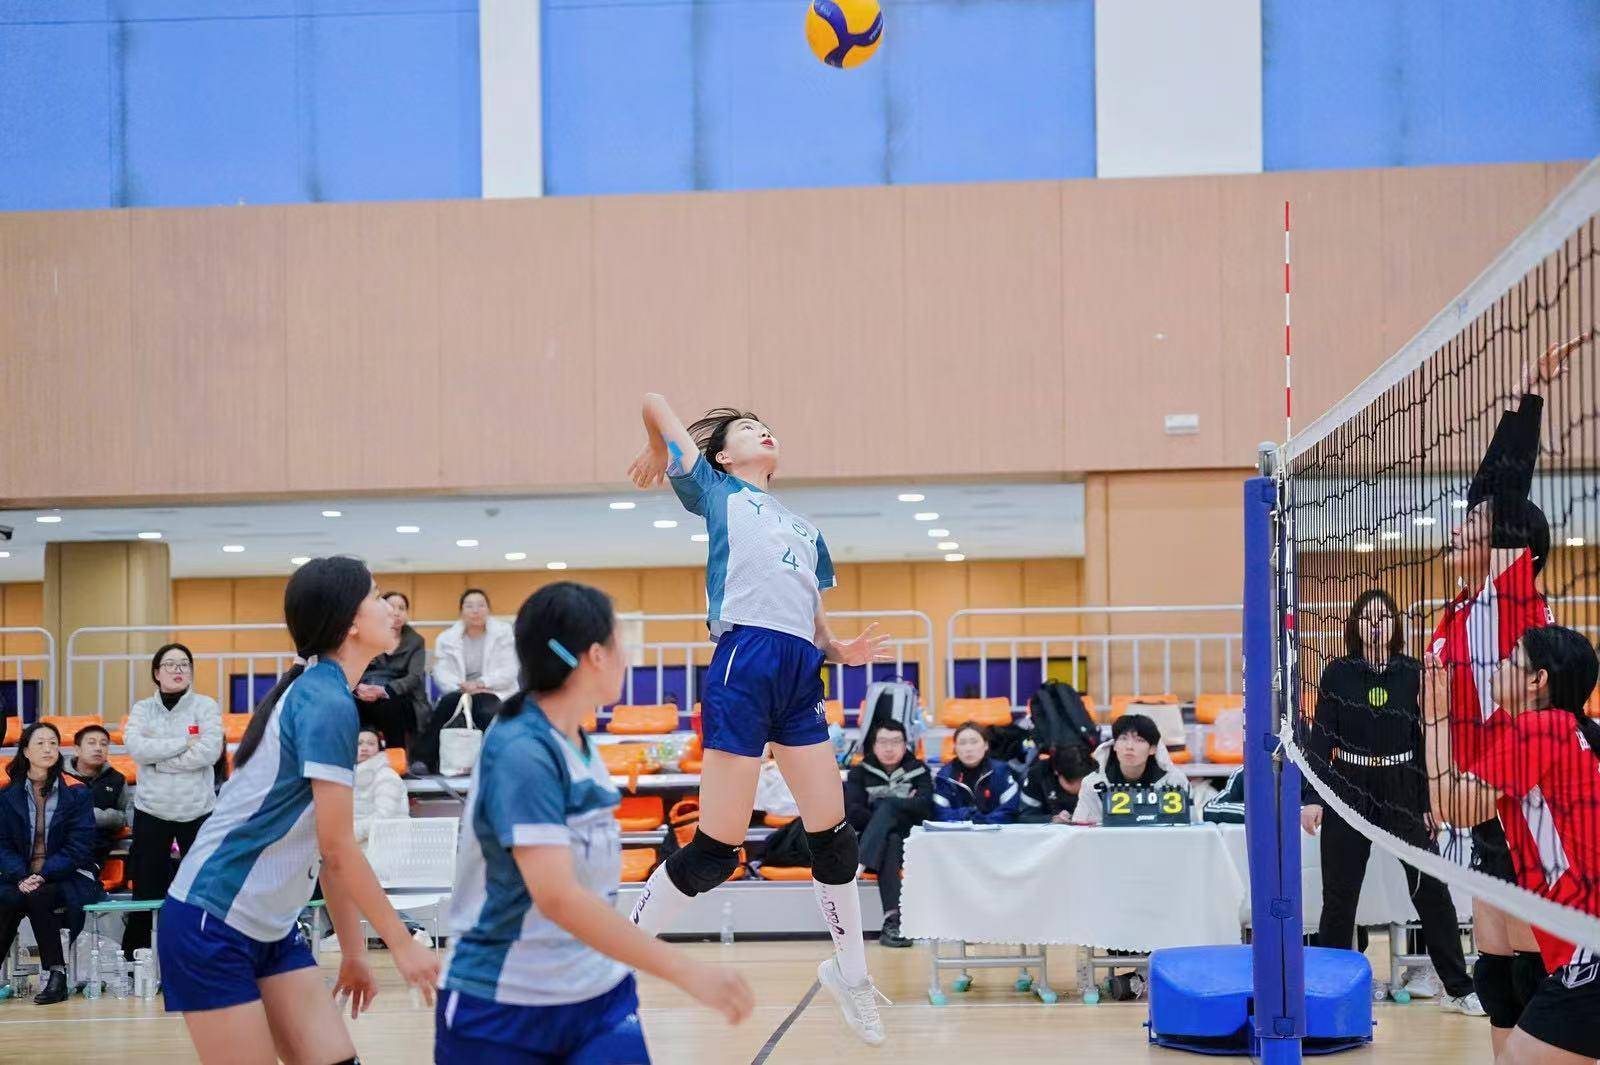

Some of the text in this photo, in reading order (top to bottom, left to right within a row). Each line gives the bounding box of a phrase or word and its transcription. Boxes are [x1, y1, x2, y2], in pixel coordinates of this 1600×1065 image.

[782, 547, 799, 570] 4
[1111, 792, 1182, 814] 2 1 0 3
